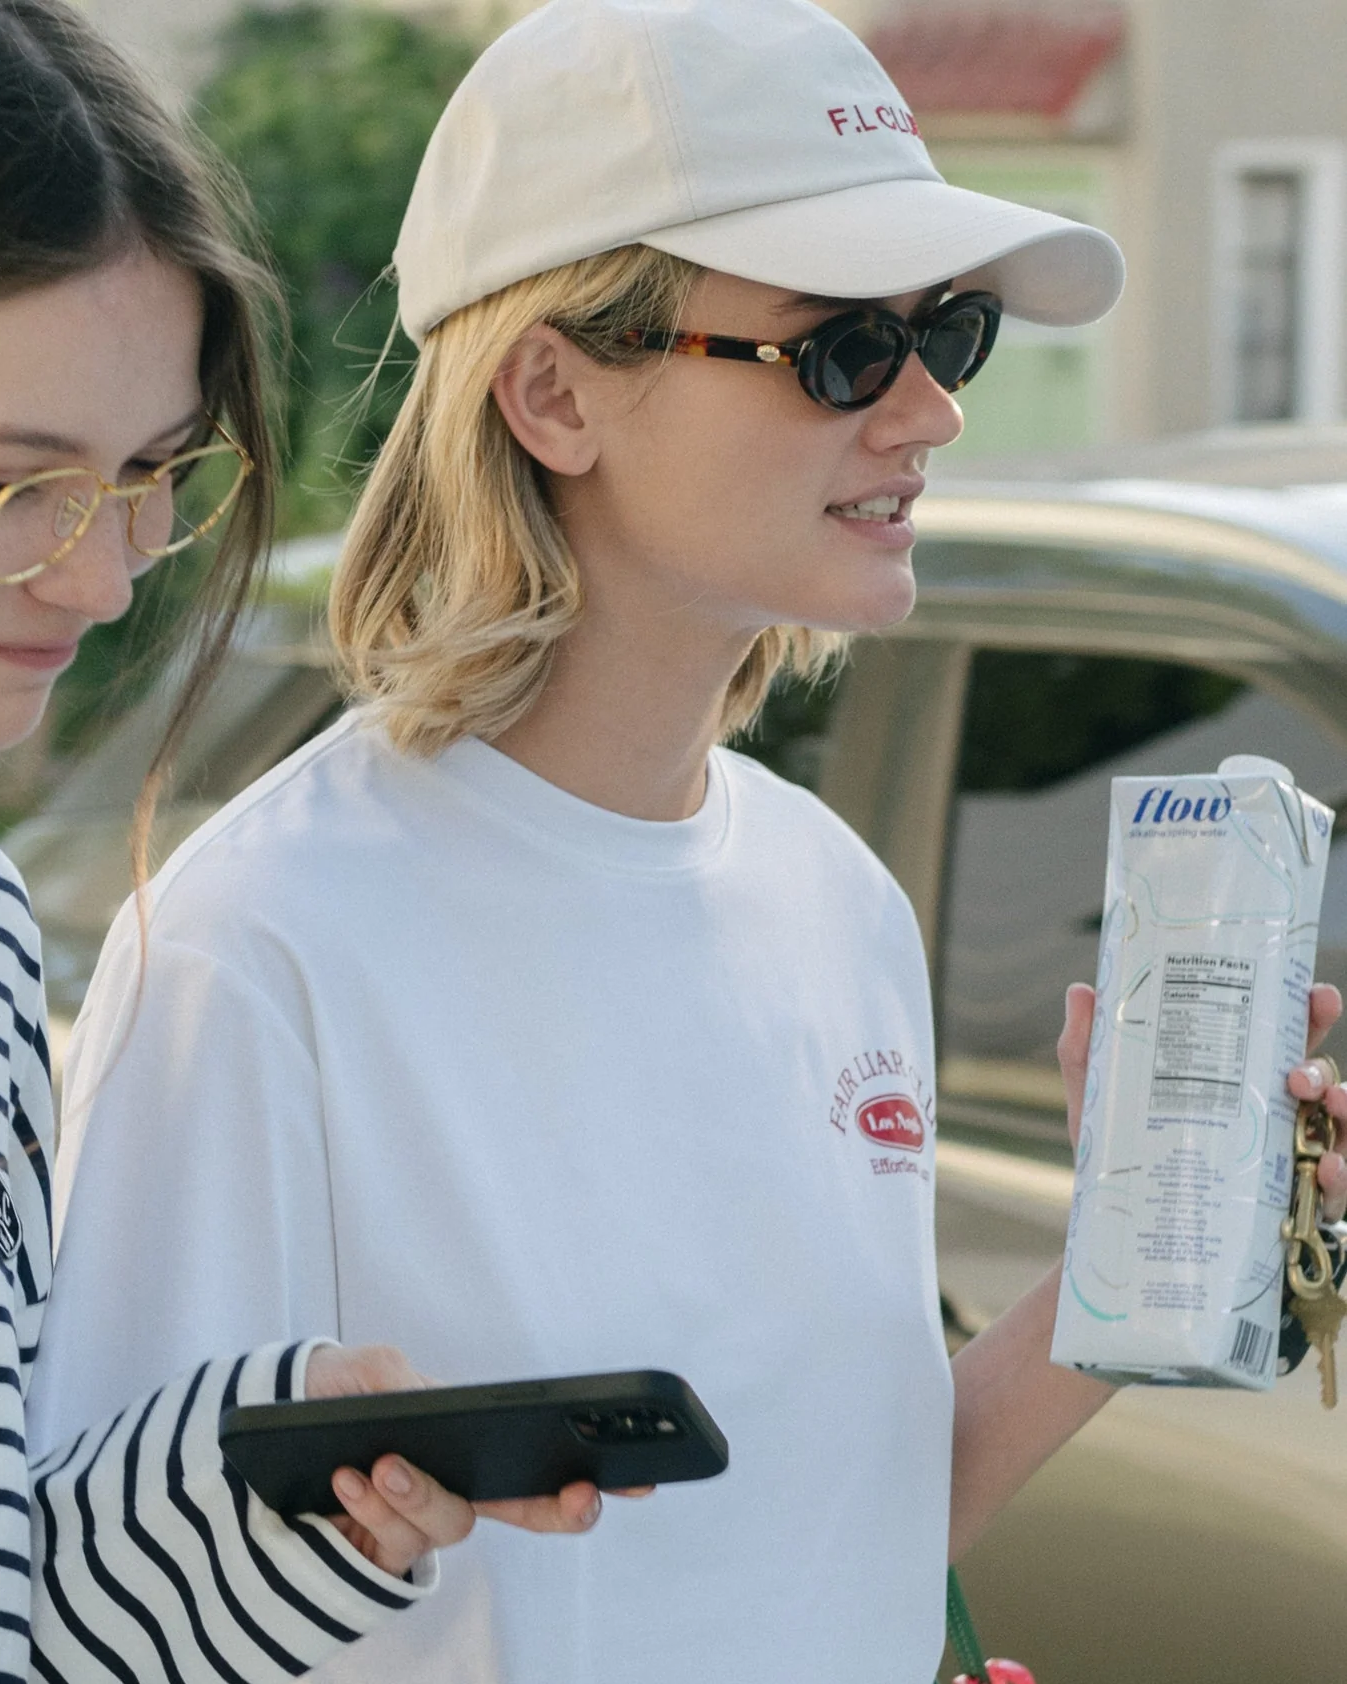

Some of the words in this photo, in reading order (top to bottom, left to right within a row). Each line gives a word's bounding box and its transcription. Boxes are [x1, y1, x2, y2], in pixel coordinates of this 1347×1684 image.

[1133, 787, 1231, 823] flow
[1167, 956, 1217, 966] Nutrition
[1219, 959, 1250, 970] Facts
[829, 1067, 859, 1136] FAIR
[853, 1049, 908, 1082] LIAR
